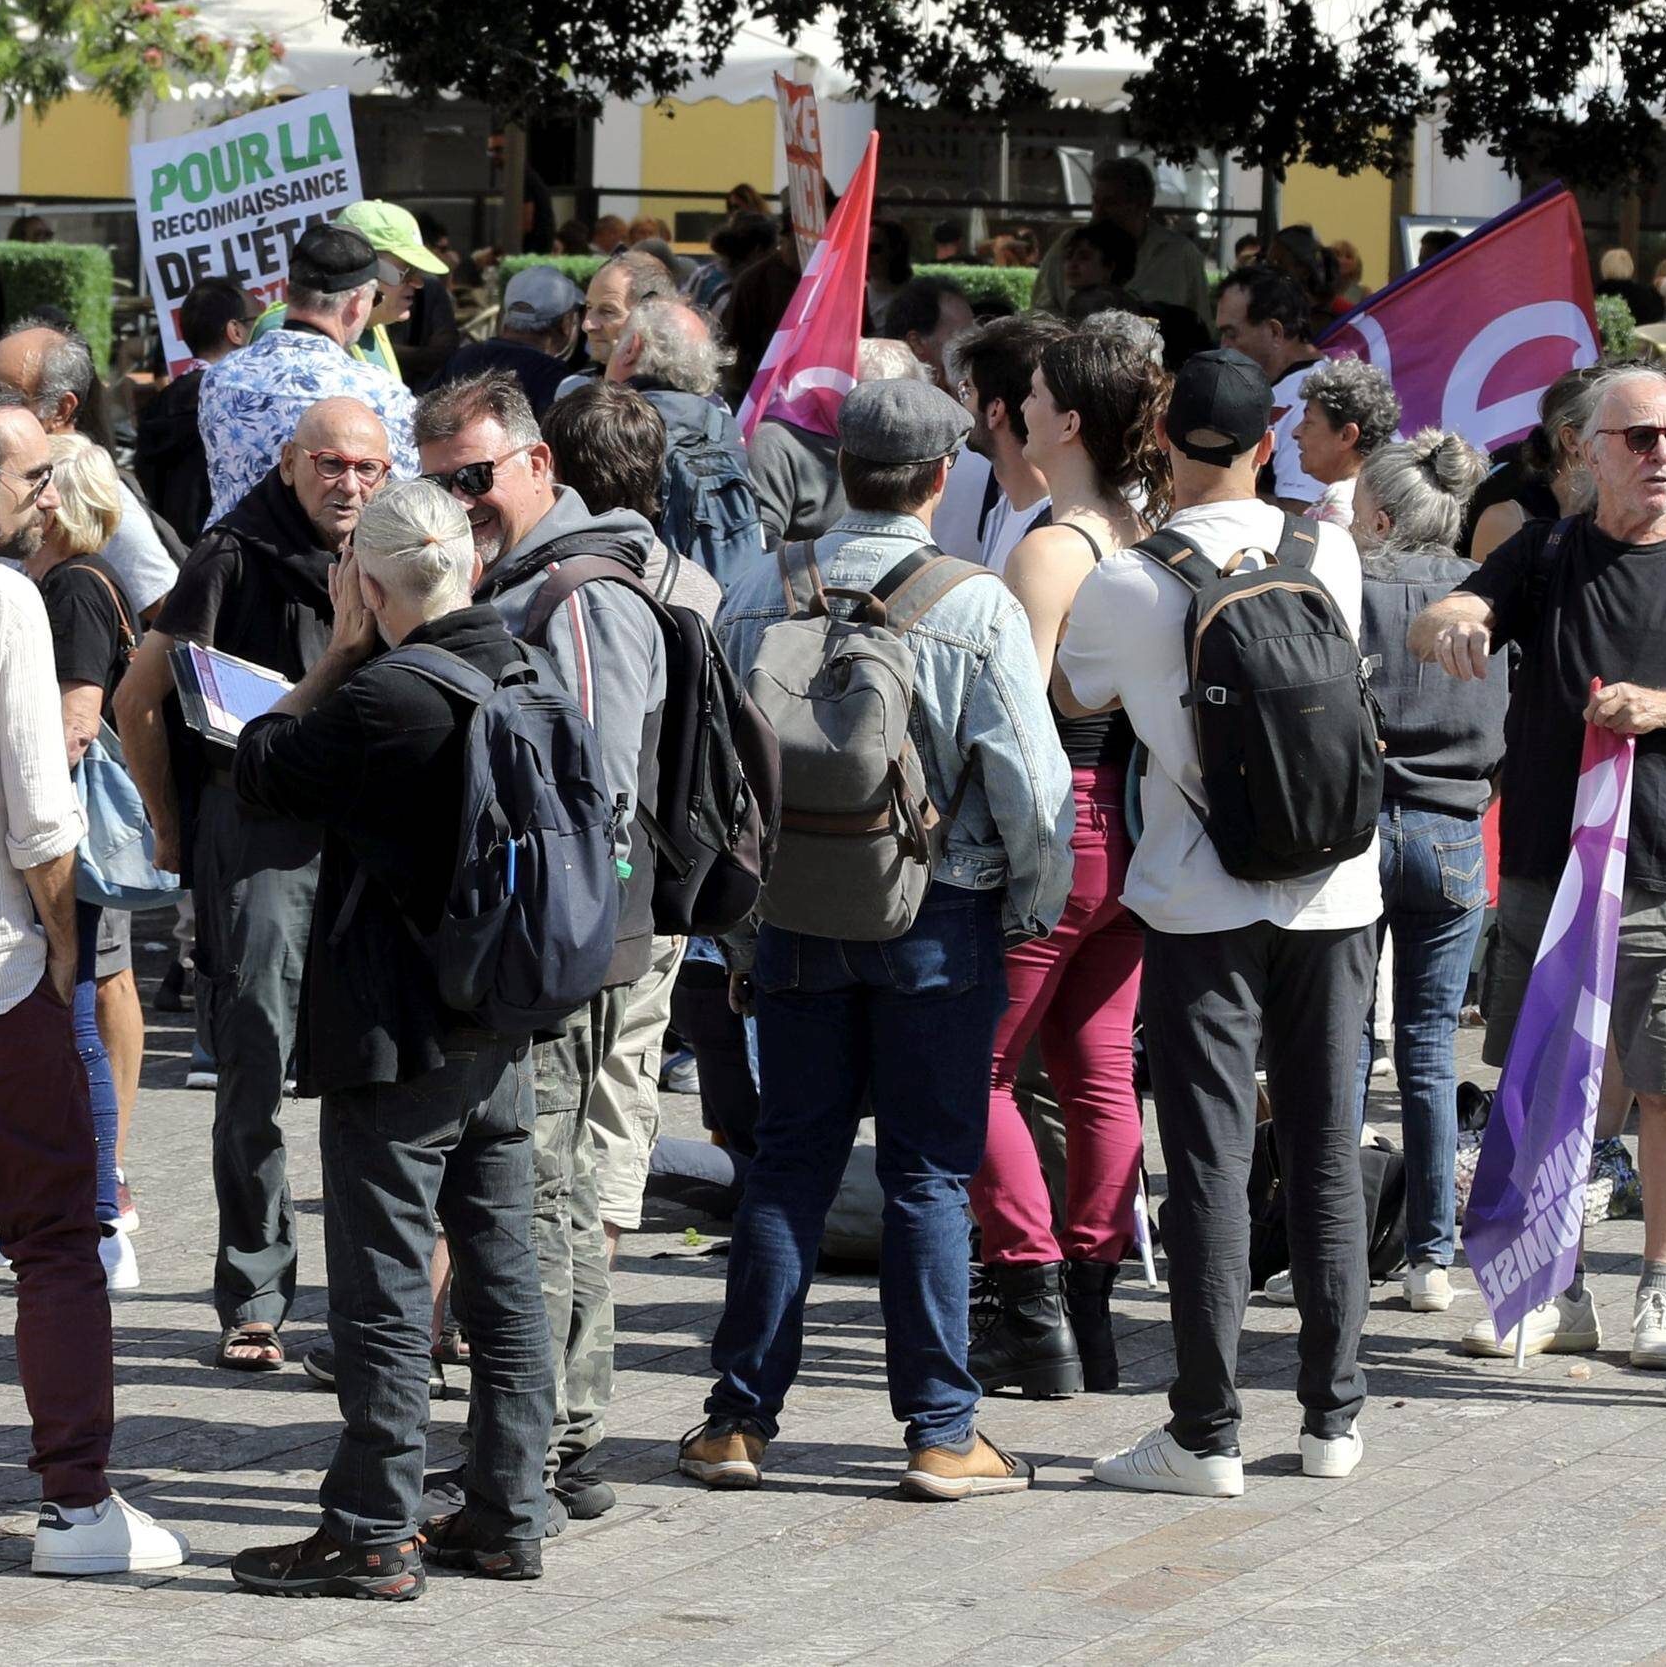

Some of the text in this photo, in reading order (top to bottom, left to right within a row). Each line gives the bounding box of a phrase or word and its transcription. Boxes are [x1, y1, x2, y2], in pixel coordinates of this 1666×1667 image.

[149, 112, 344, 213] POUR LA
[151, 168, 349, 242] RECONNAISSANCE
[155, 205, 346, 301] DE L'ÉT
